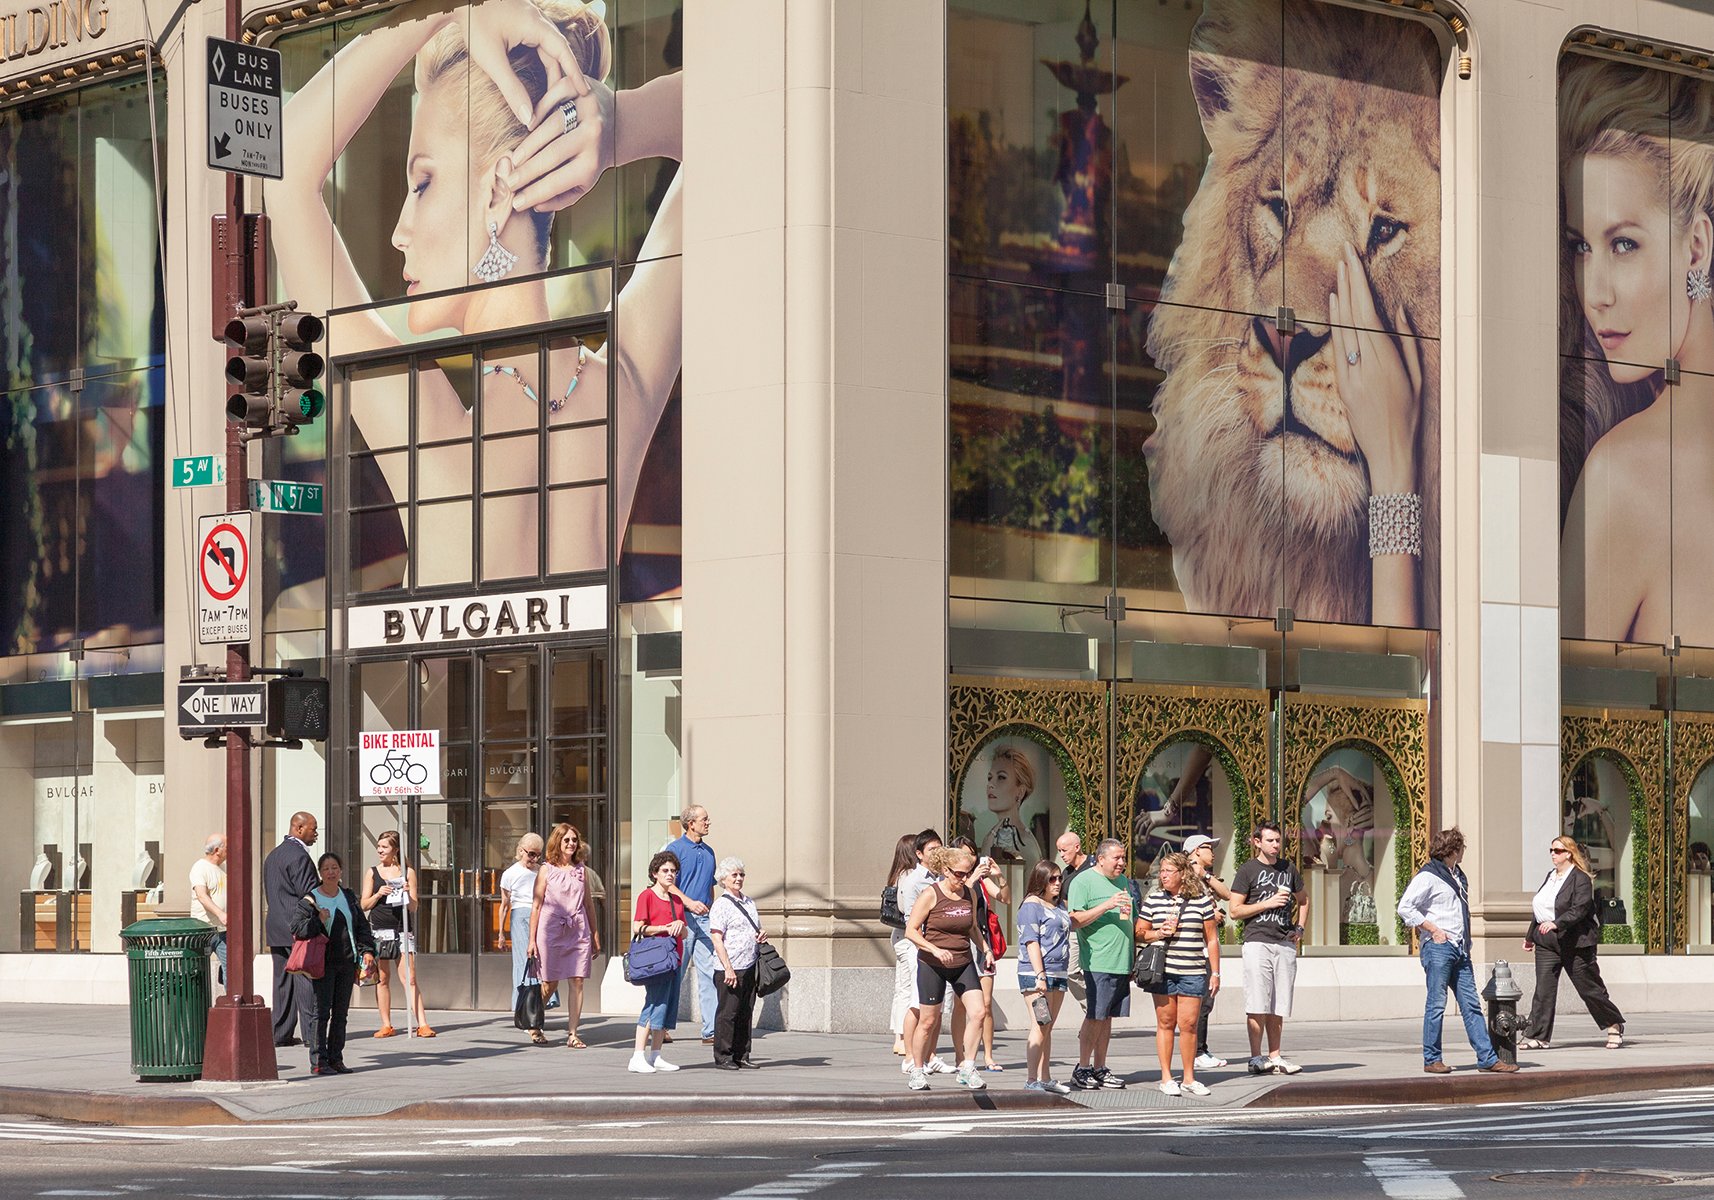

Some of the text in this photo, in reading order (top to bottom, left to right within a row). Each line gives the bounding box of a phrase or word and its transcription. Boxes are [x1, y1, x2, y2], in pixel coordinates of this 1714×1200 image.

[237, 52, 269, 71] BUS
[234, 70, 273, 90] LANE
[220, 91, 269, 116] BUSES
[235, 118, 273, 140] ONLY
[182, 459, 209, 484] 5 AV
[274, 484, 320, 510] W 57 ST
[201, 605, 249, 623] 7AM-7PM
[382, 594, 571, 645] BVLGARI
[201, 624, 248, 636] EXCEPT BUSES
[192, 696, 256, 713] ONE WAY
[363, 732, 435, 749] BIKE RENTAL
[489, 764, 534, 776] BVLGARI
[372, 785, 425, 795] 56 W 56th St.
